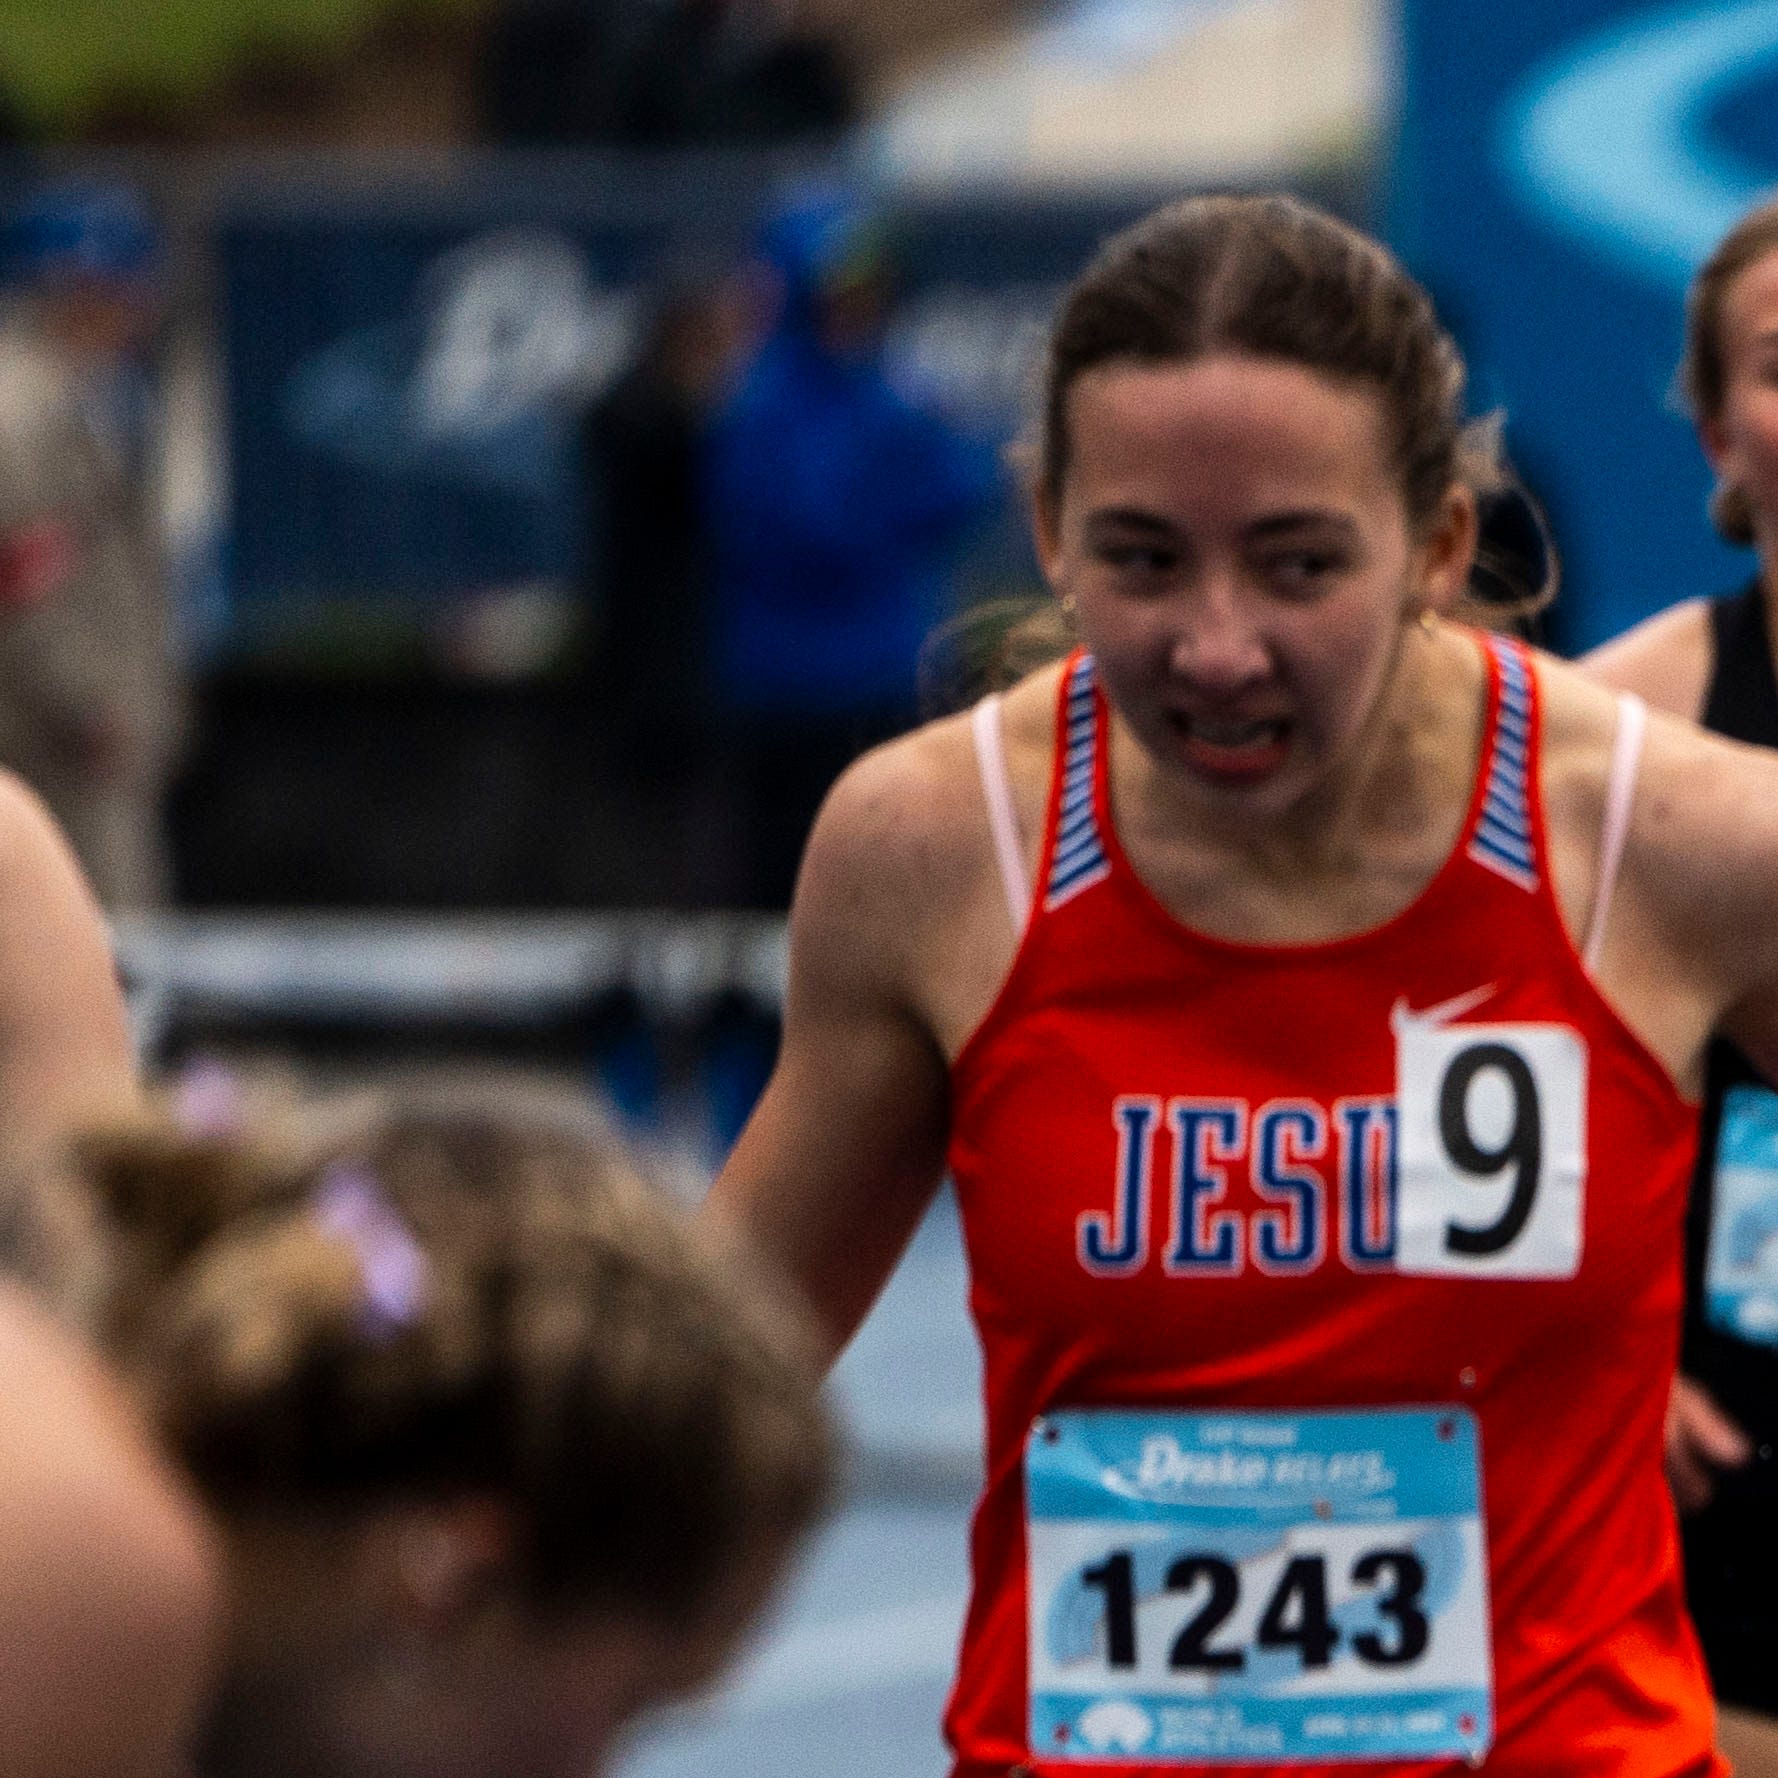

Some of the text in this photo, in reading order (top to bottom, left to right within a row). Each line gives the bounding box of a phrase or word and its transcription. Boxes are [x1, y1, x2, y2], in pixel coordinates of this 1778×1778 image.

[1075, 1093, 1399, 1278] JESU
[1437, 1041, 1543, 1259] 9
[1081, 1547, 1431, 1672] 1243
